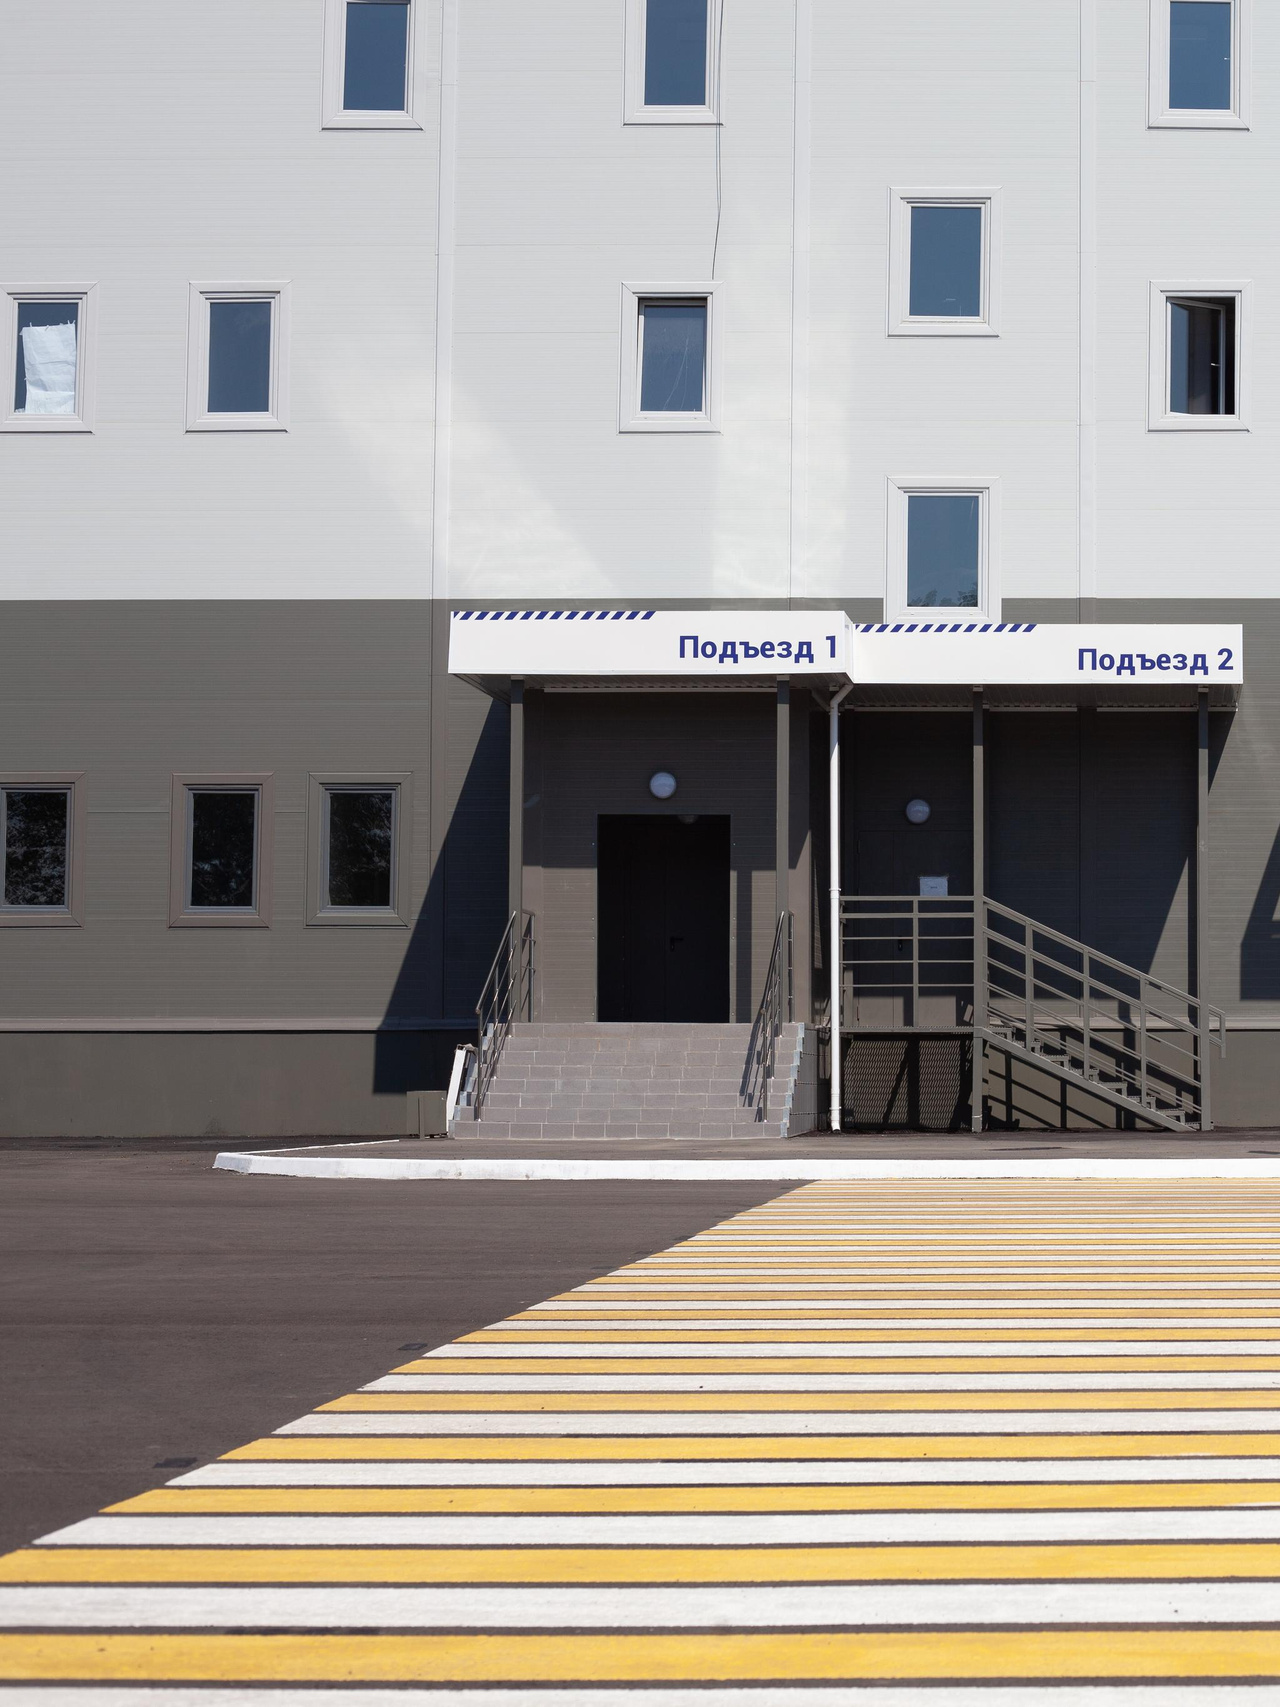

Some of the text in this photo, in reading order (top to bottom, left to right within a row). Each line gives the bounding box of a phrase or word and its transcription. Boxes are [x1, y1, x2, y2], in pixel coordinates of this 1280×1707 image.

[679, 635, 836, 664] Подъезд 1
[1078, 648, 1234, 676] Подъезд 2
